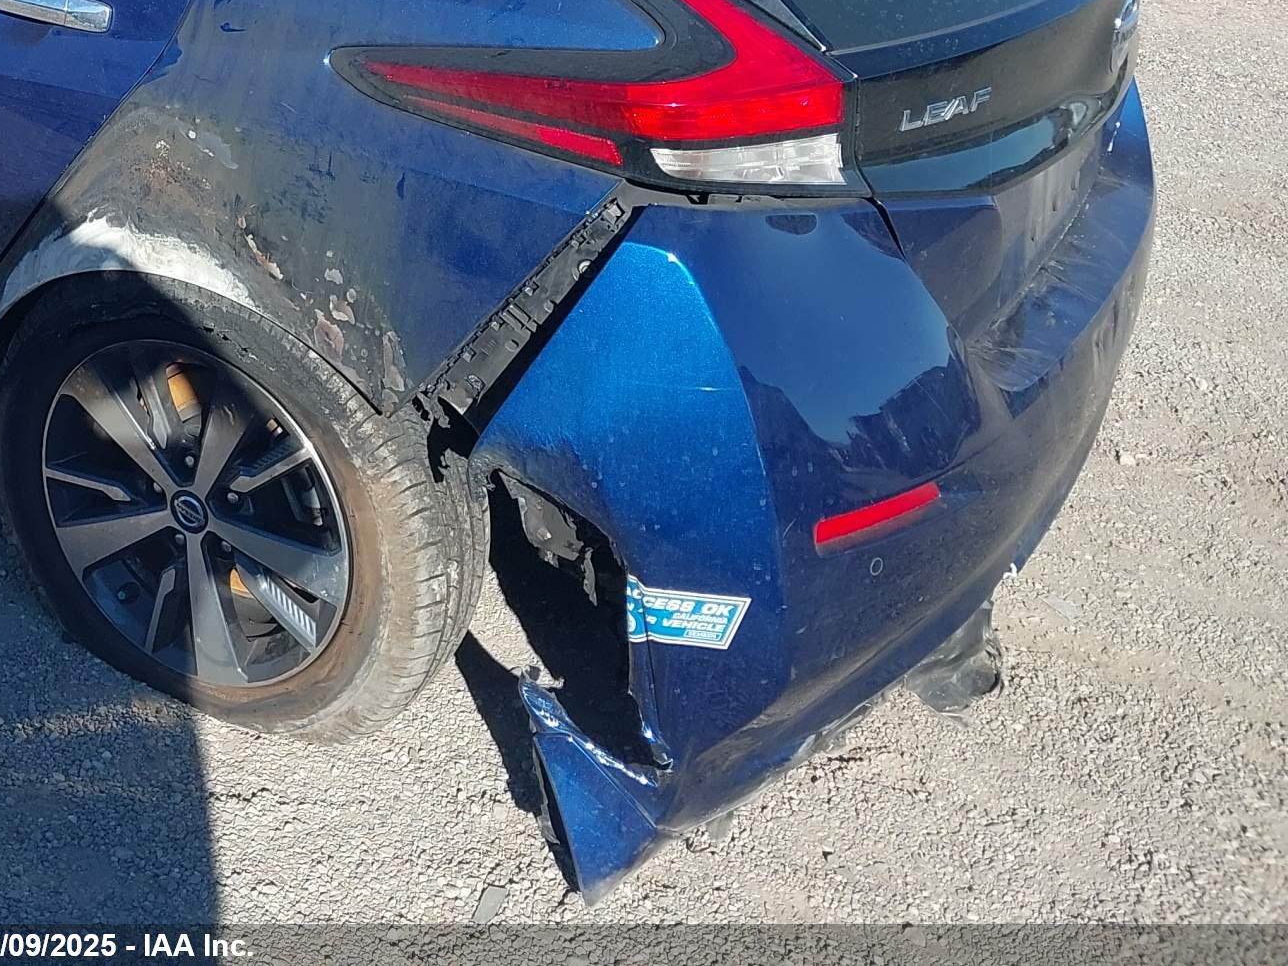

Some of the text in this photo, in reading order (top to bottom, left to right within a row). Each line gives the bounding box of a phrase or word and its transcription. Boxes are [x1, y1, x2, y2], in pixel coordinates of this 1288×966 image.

[899, 87, 992, 132] LEAF
[701, 603, 735, 617] OK
[662, 618, 726, 632] VEHICLE
